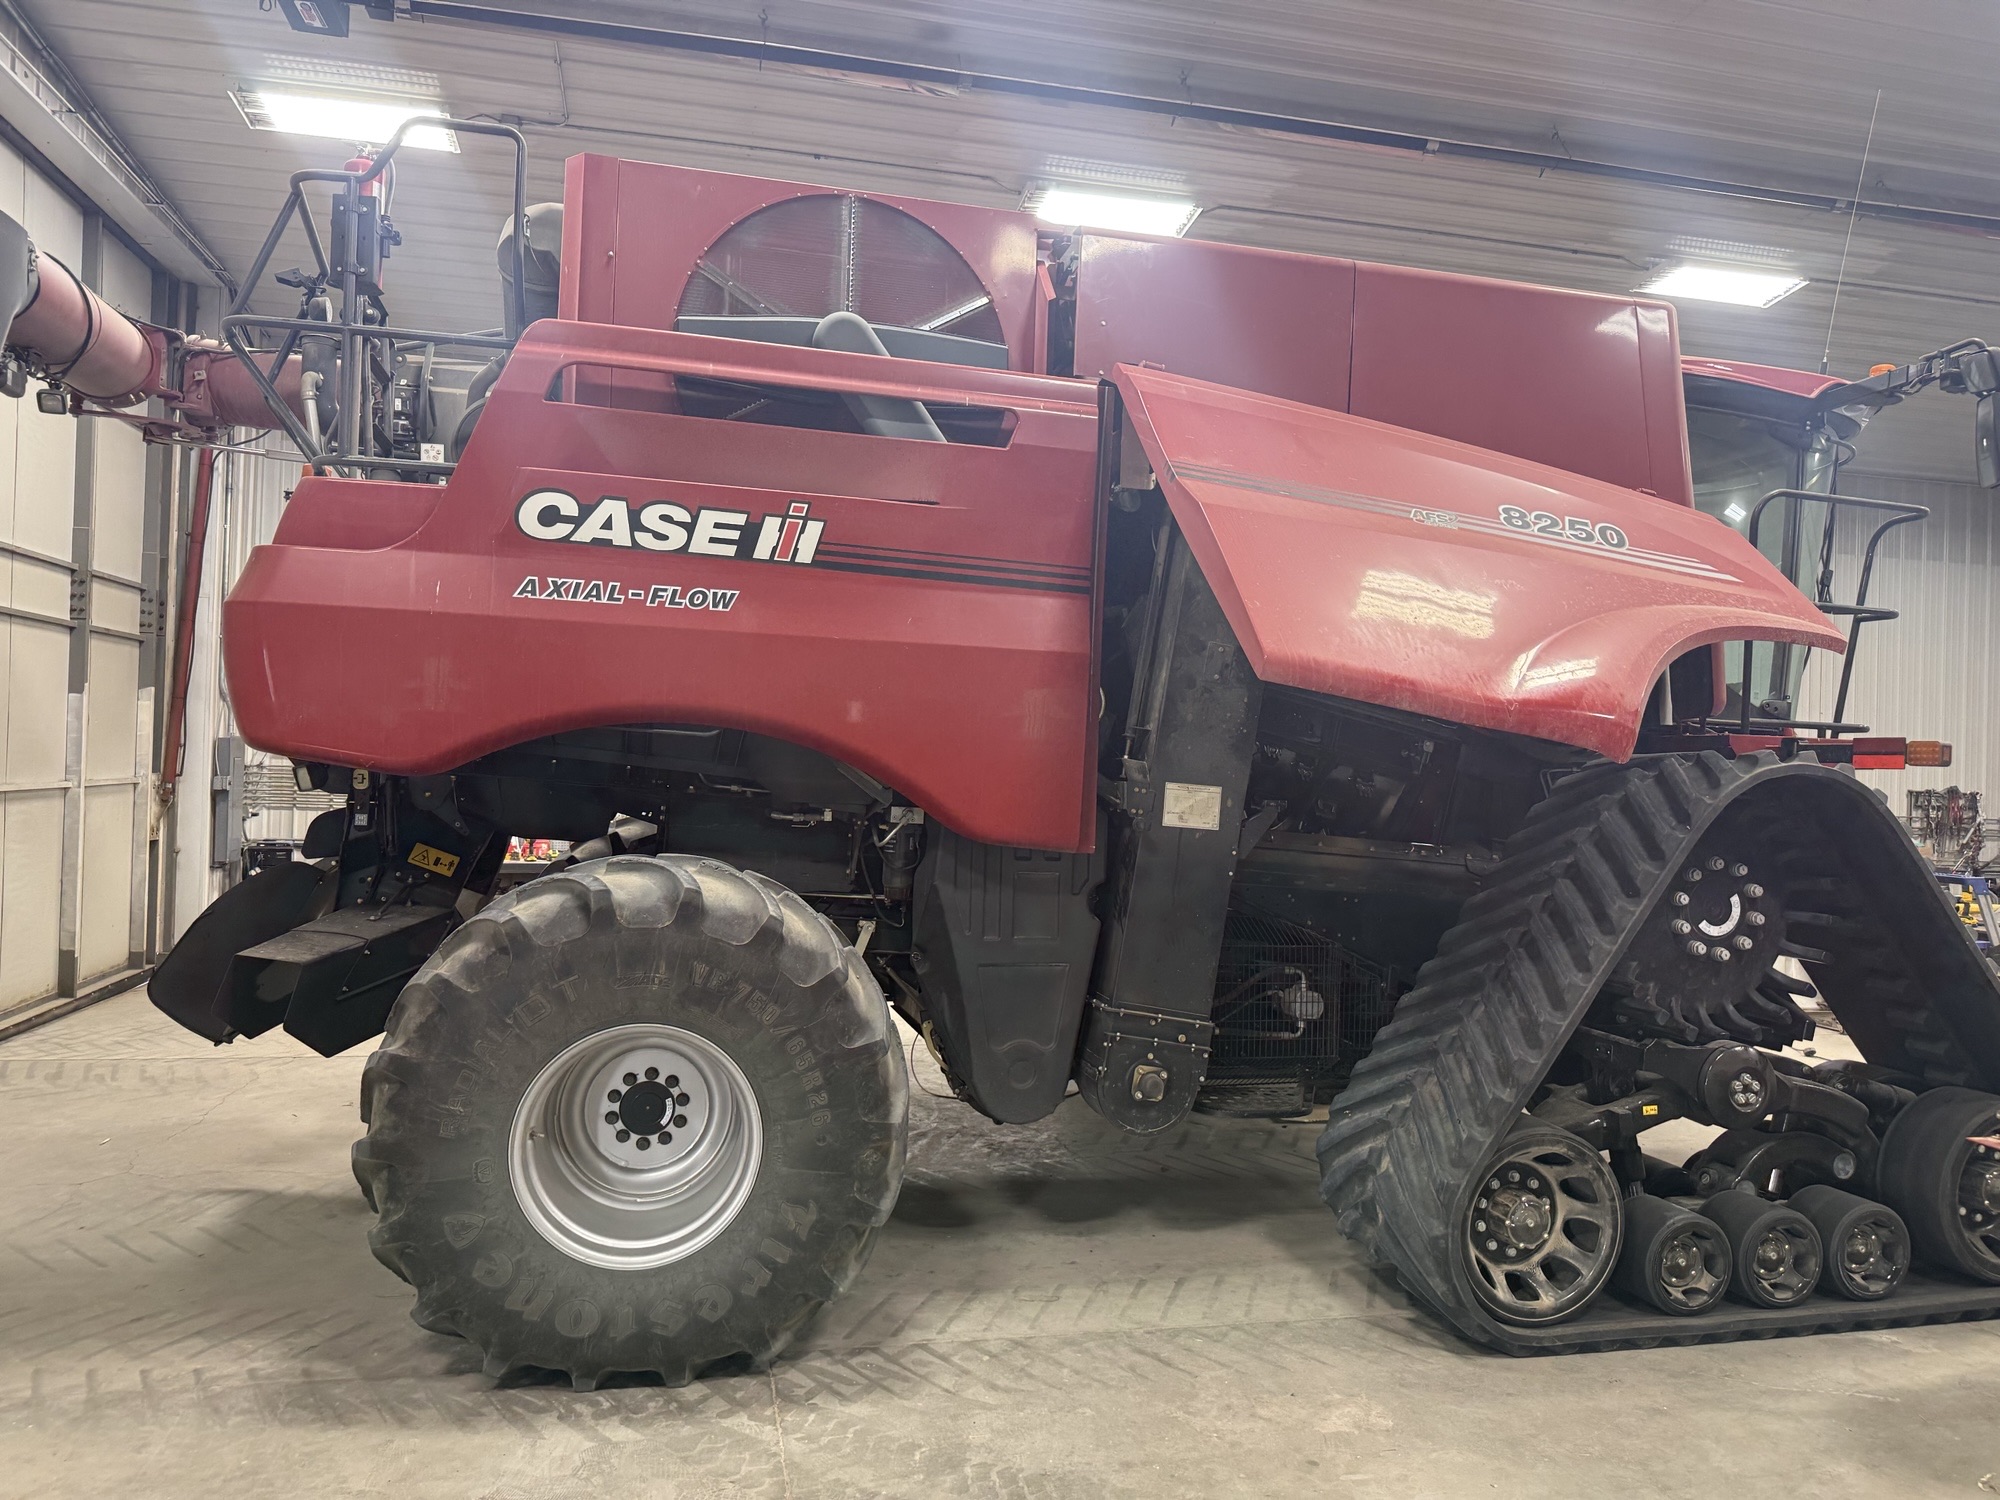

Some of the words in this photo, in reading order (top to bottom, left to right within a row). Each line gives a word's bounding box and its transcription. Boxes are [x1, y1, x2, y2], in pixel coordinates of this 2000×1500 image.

[516, 490, 748, 558] CASE
[1498, 505, 1628, 549] 8250
[472, 1200, 817, 1341] Firestone
